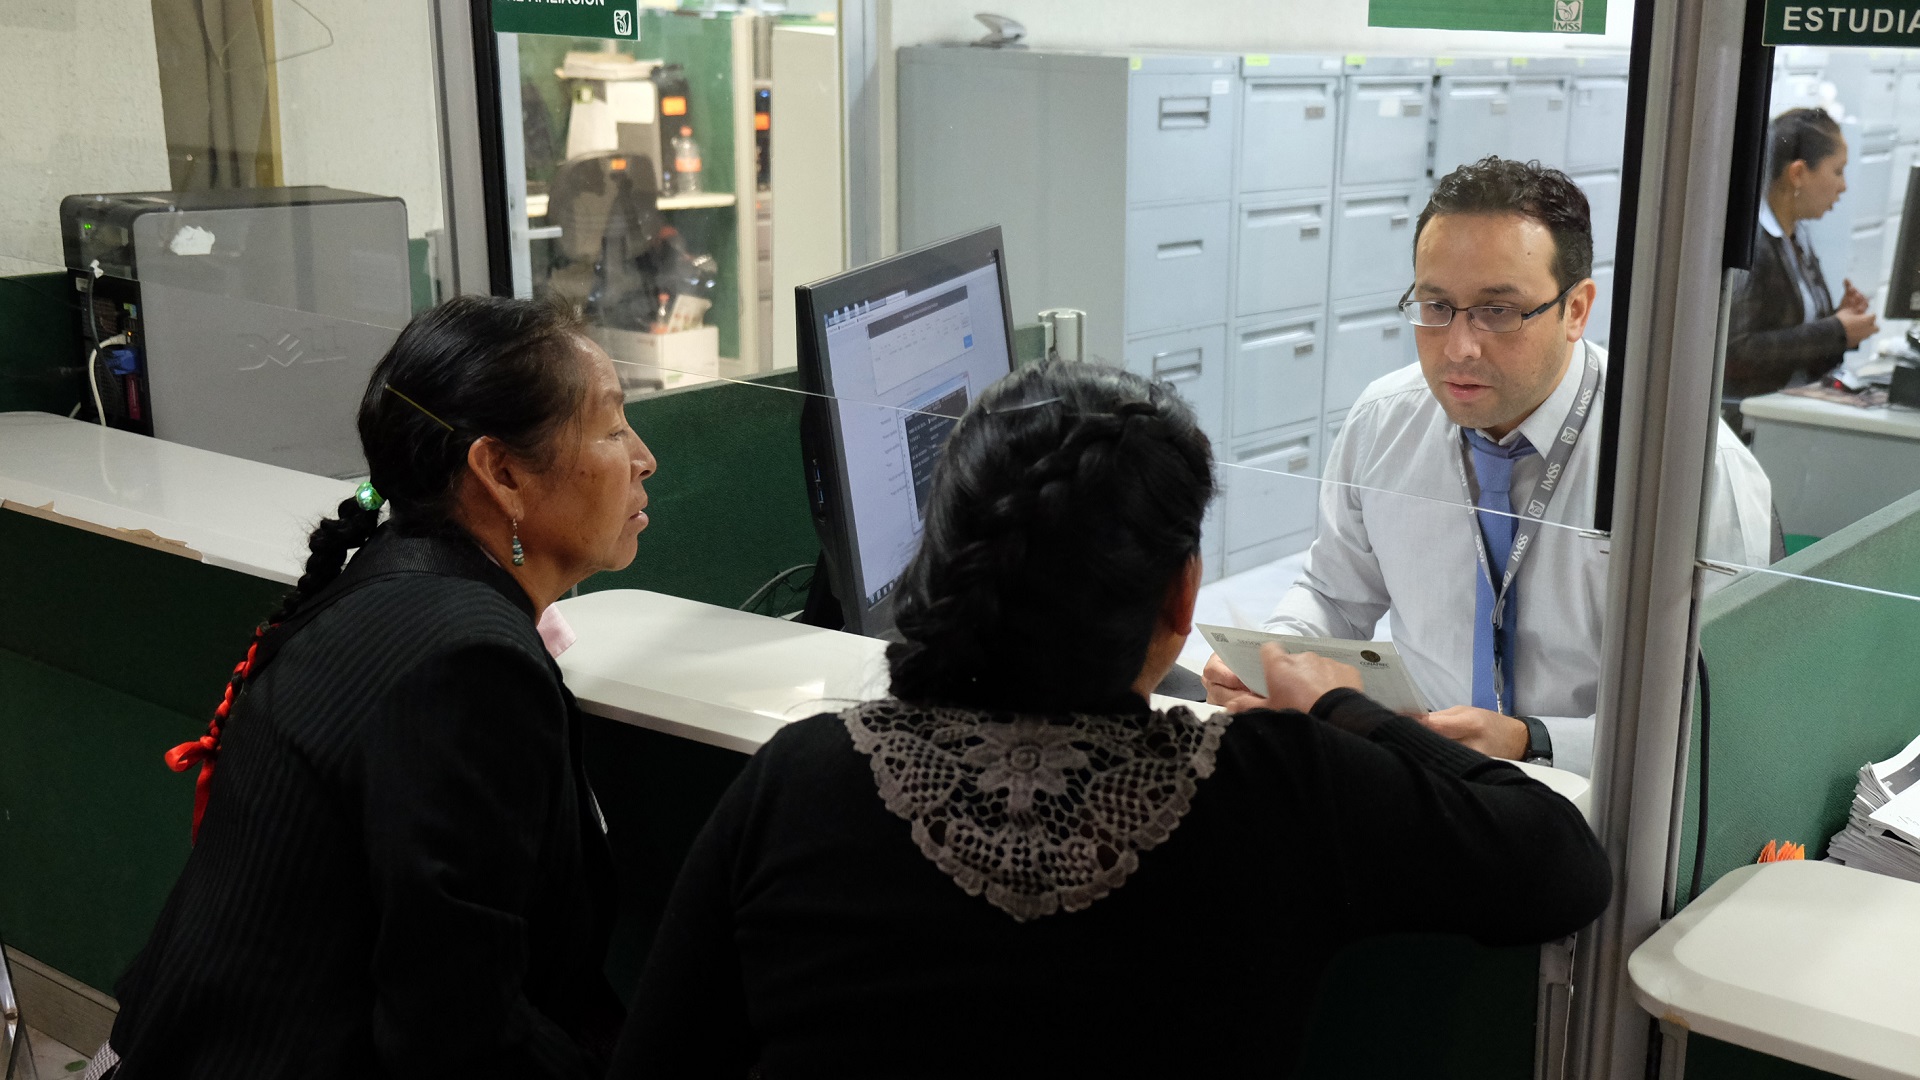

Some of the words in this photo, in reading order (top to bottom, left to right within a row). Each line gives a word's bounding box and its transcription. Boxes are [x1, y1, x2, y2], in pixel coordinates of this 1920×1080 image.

[1553, 21, 1581, 32] IMSS
[1783, 6, 1920, 34] ESTUDIA
[237, 326, 347, 371] DELL
[1575, 388, 1592, 417] IMSS
[1540, 462, 1561, 491] IMSS
[1475, 534, 1485, 563] IMSS
[1511, 533, 1529, 562] IMSS
